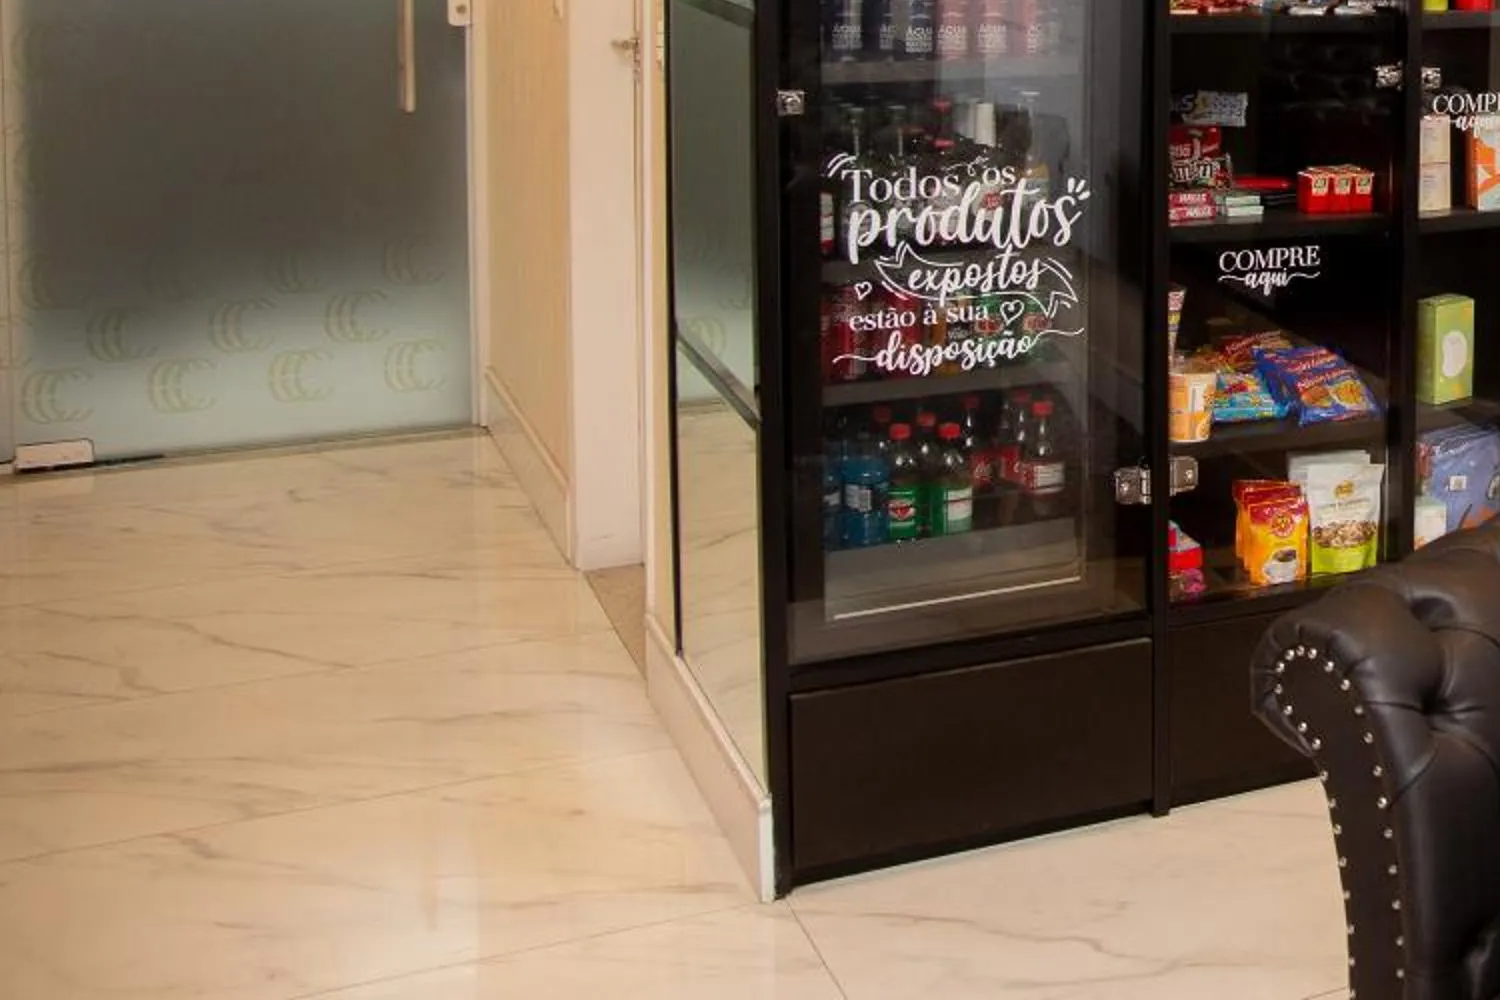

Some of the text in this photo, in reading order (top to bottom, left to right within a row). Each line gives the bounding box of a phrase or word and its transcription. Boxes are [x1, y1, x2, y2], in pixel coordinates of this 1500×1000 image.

[841, 165, 1016, 203] Todos os
[848, 179, 1083, 265] produtos
[908, 244, 1042, 307] expostos
[1219, 245, 1321, 272] COMPRE
[849, 302, 990, 332] estão à sua
[875, 330, 1034, 377] disposição
